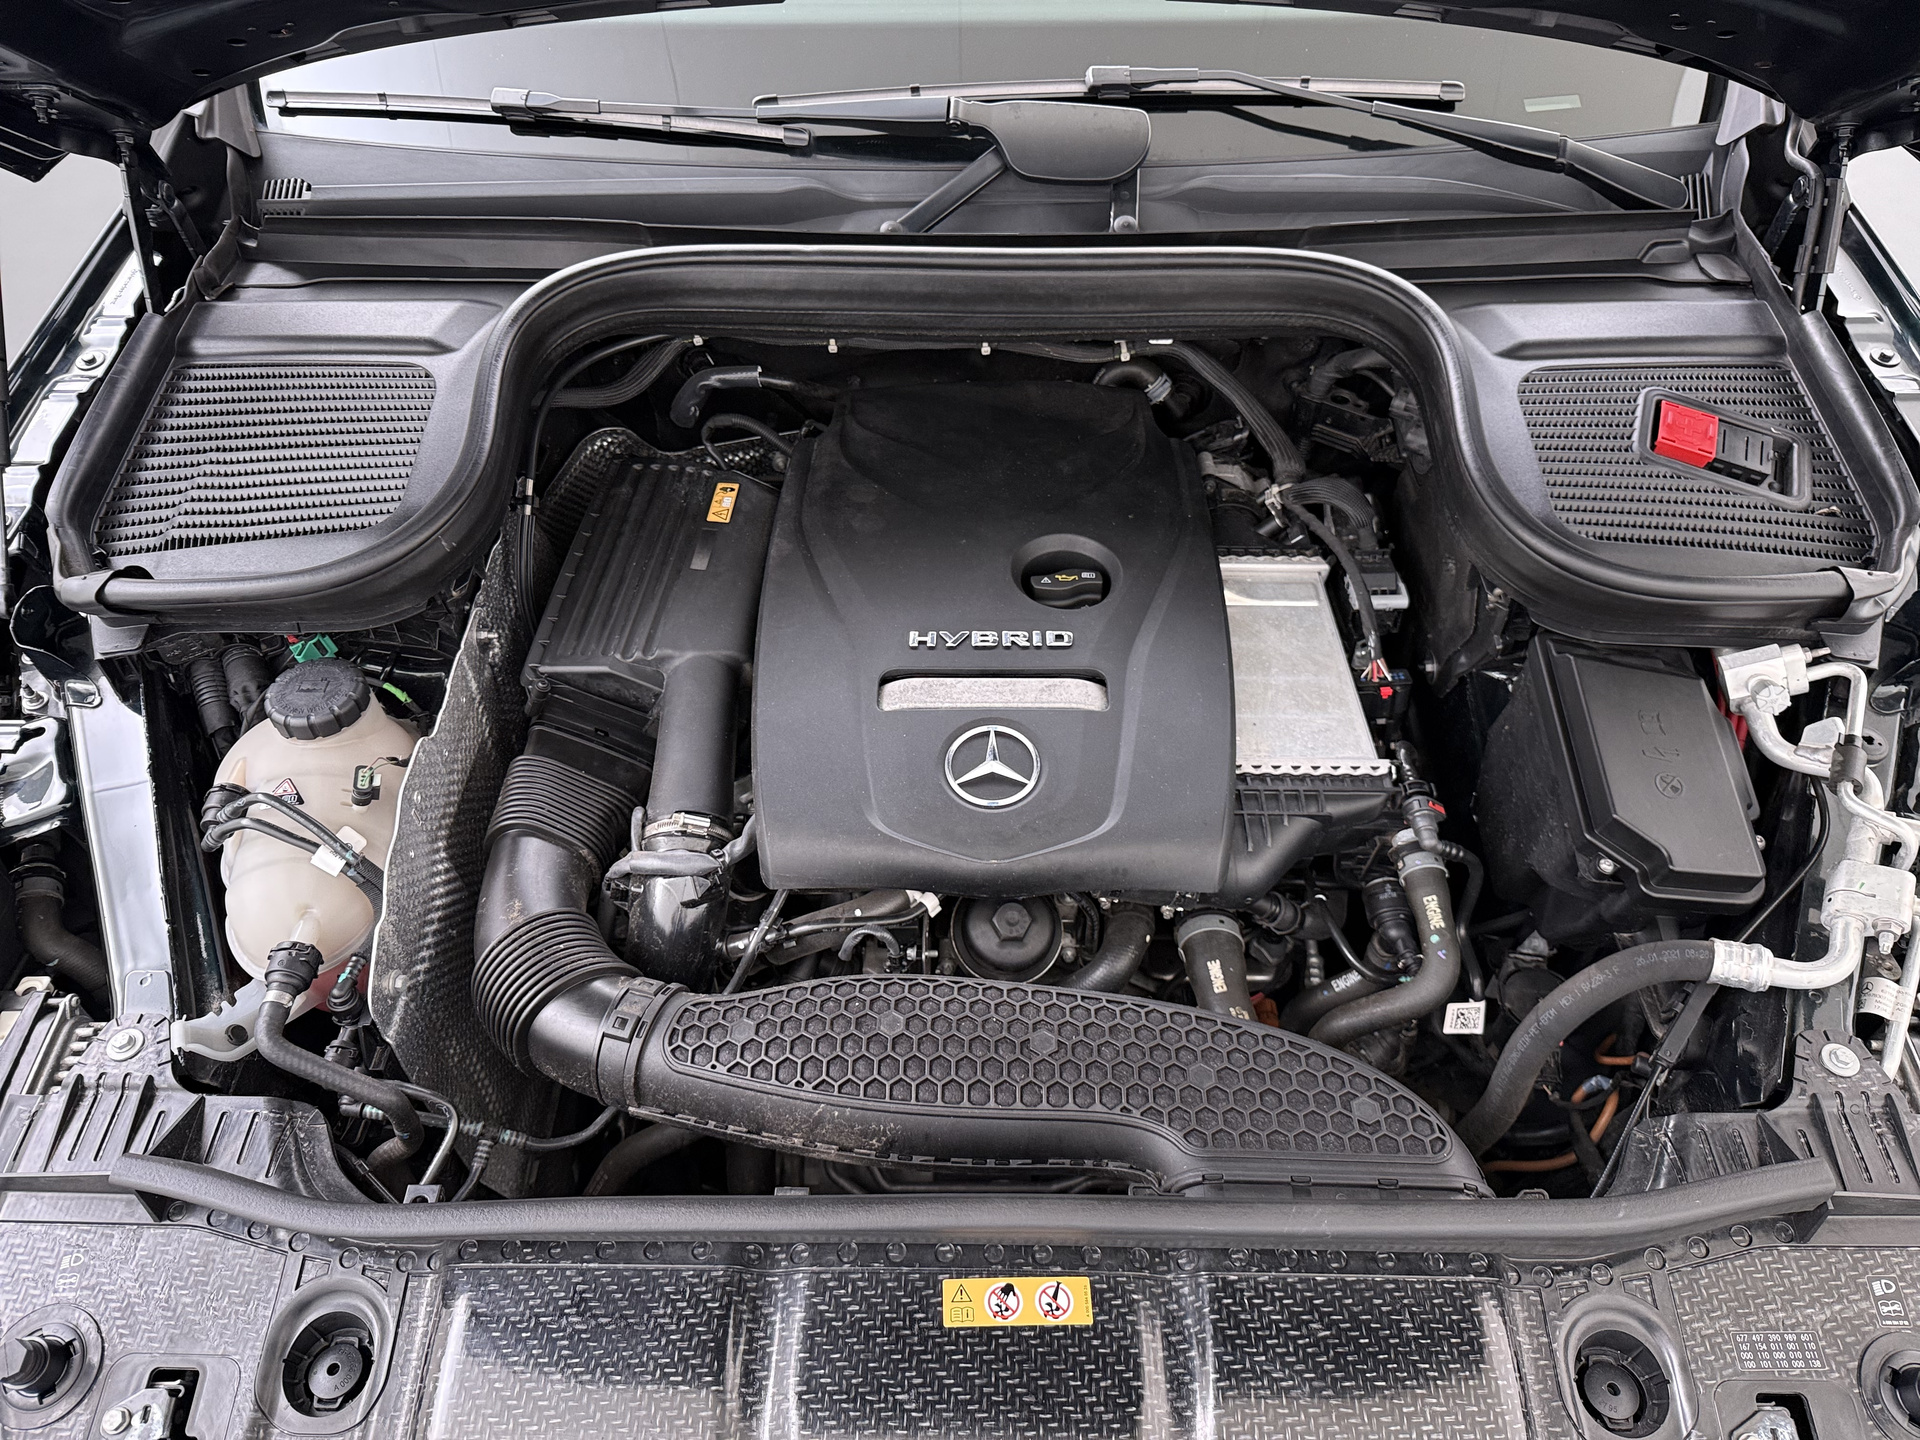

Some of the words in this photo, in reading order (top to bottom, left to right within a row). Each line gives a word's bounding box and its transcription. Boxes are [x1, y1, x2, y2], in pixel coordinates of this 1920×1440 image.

[908, 630, 1074, 648] HYBRID
[1422, 894, 1446, 930] ENGINE
[1206, 959, 1228, 994] ENGINE
[1741, 1351, 1753, 1359] 000
[1757, 1351, 1770, 1359] 110
[1773, 1351, 1786, 1359] 000
[1789, 1351, 1802, 1359] 010
[1805, 1351, 1818, 1359] 011
[1743, 1360, 1756, 1368] 100
[1760, 1360, 1772, 1368] 101
[1776, 1360, 1788, 1368] 110
[1792, 1360, 1805, 1368] 000
